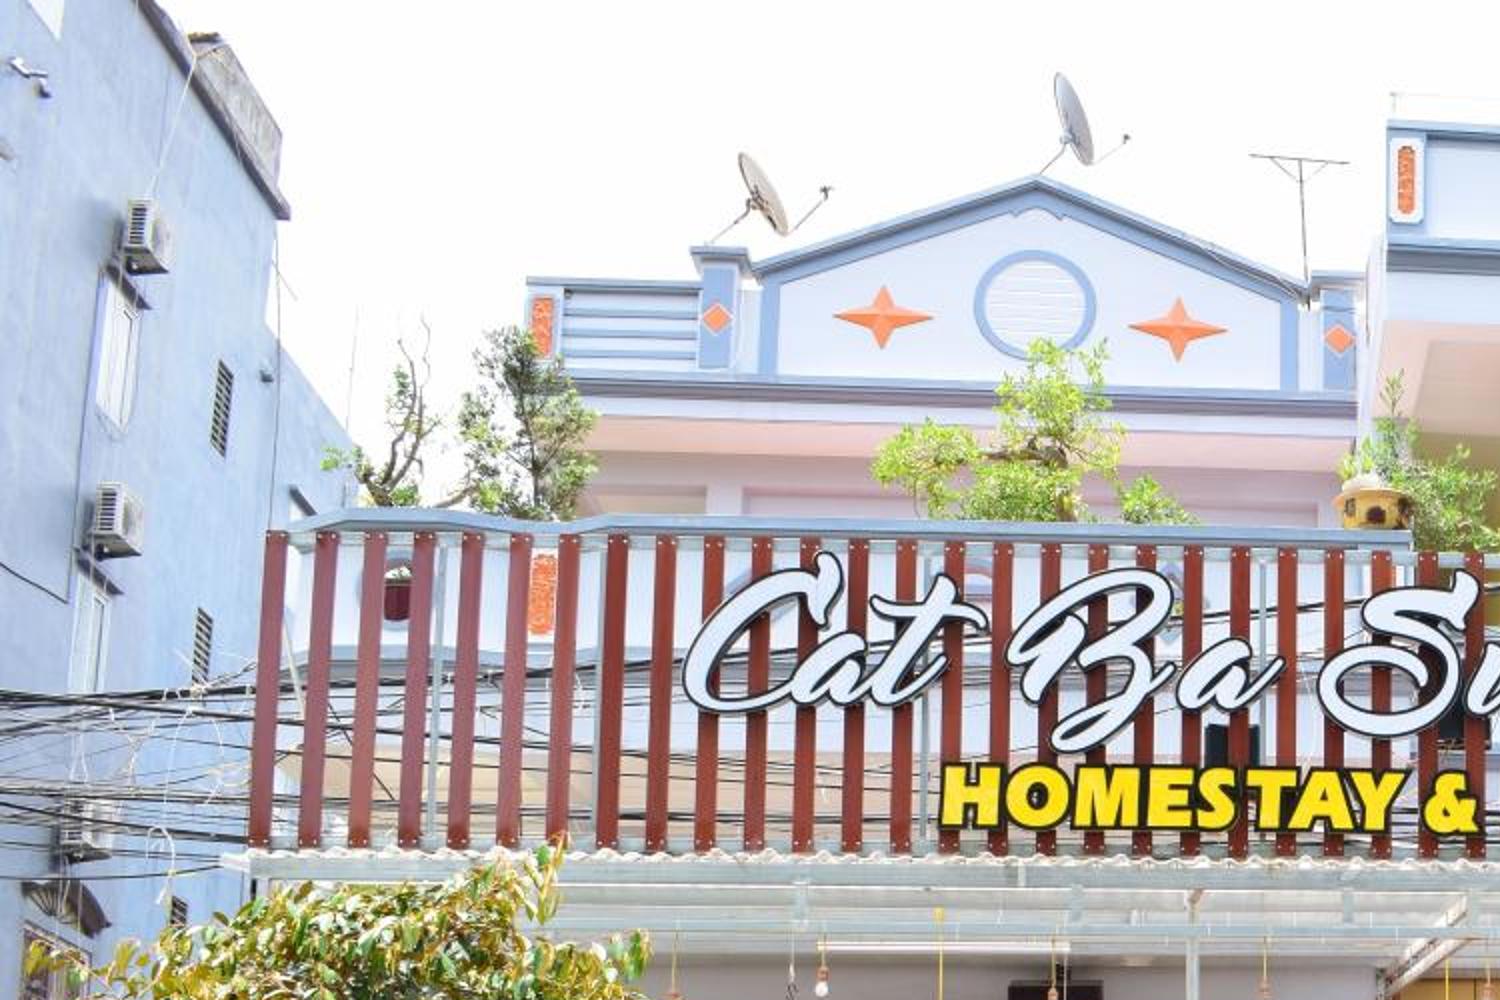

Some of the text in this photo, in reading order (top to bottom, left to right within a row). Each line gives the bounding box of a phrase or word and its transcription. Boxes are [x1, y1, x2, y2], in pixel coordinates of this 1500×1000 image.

[682, 551, 988, 713] Cat
[1004, 567, 1284, 753] Ba
[940, 761, 1412, 836] HOMESTAY
[1423, 770, 1478, 837] &
